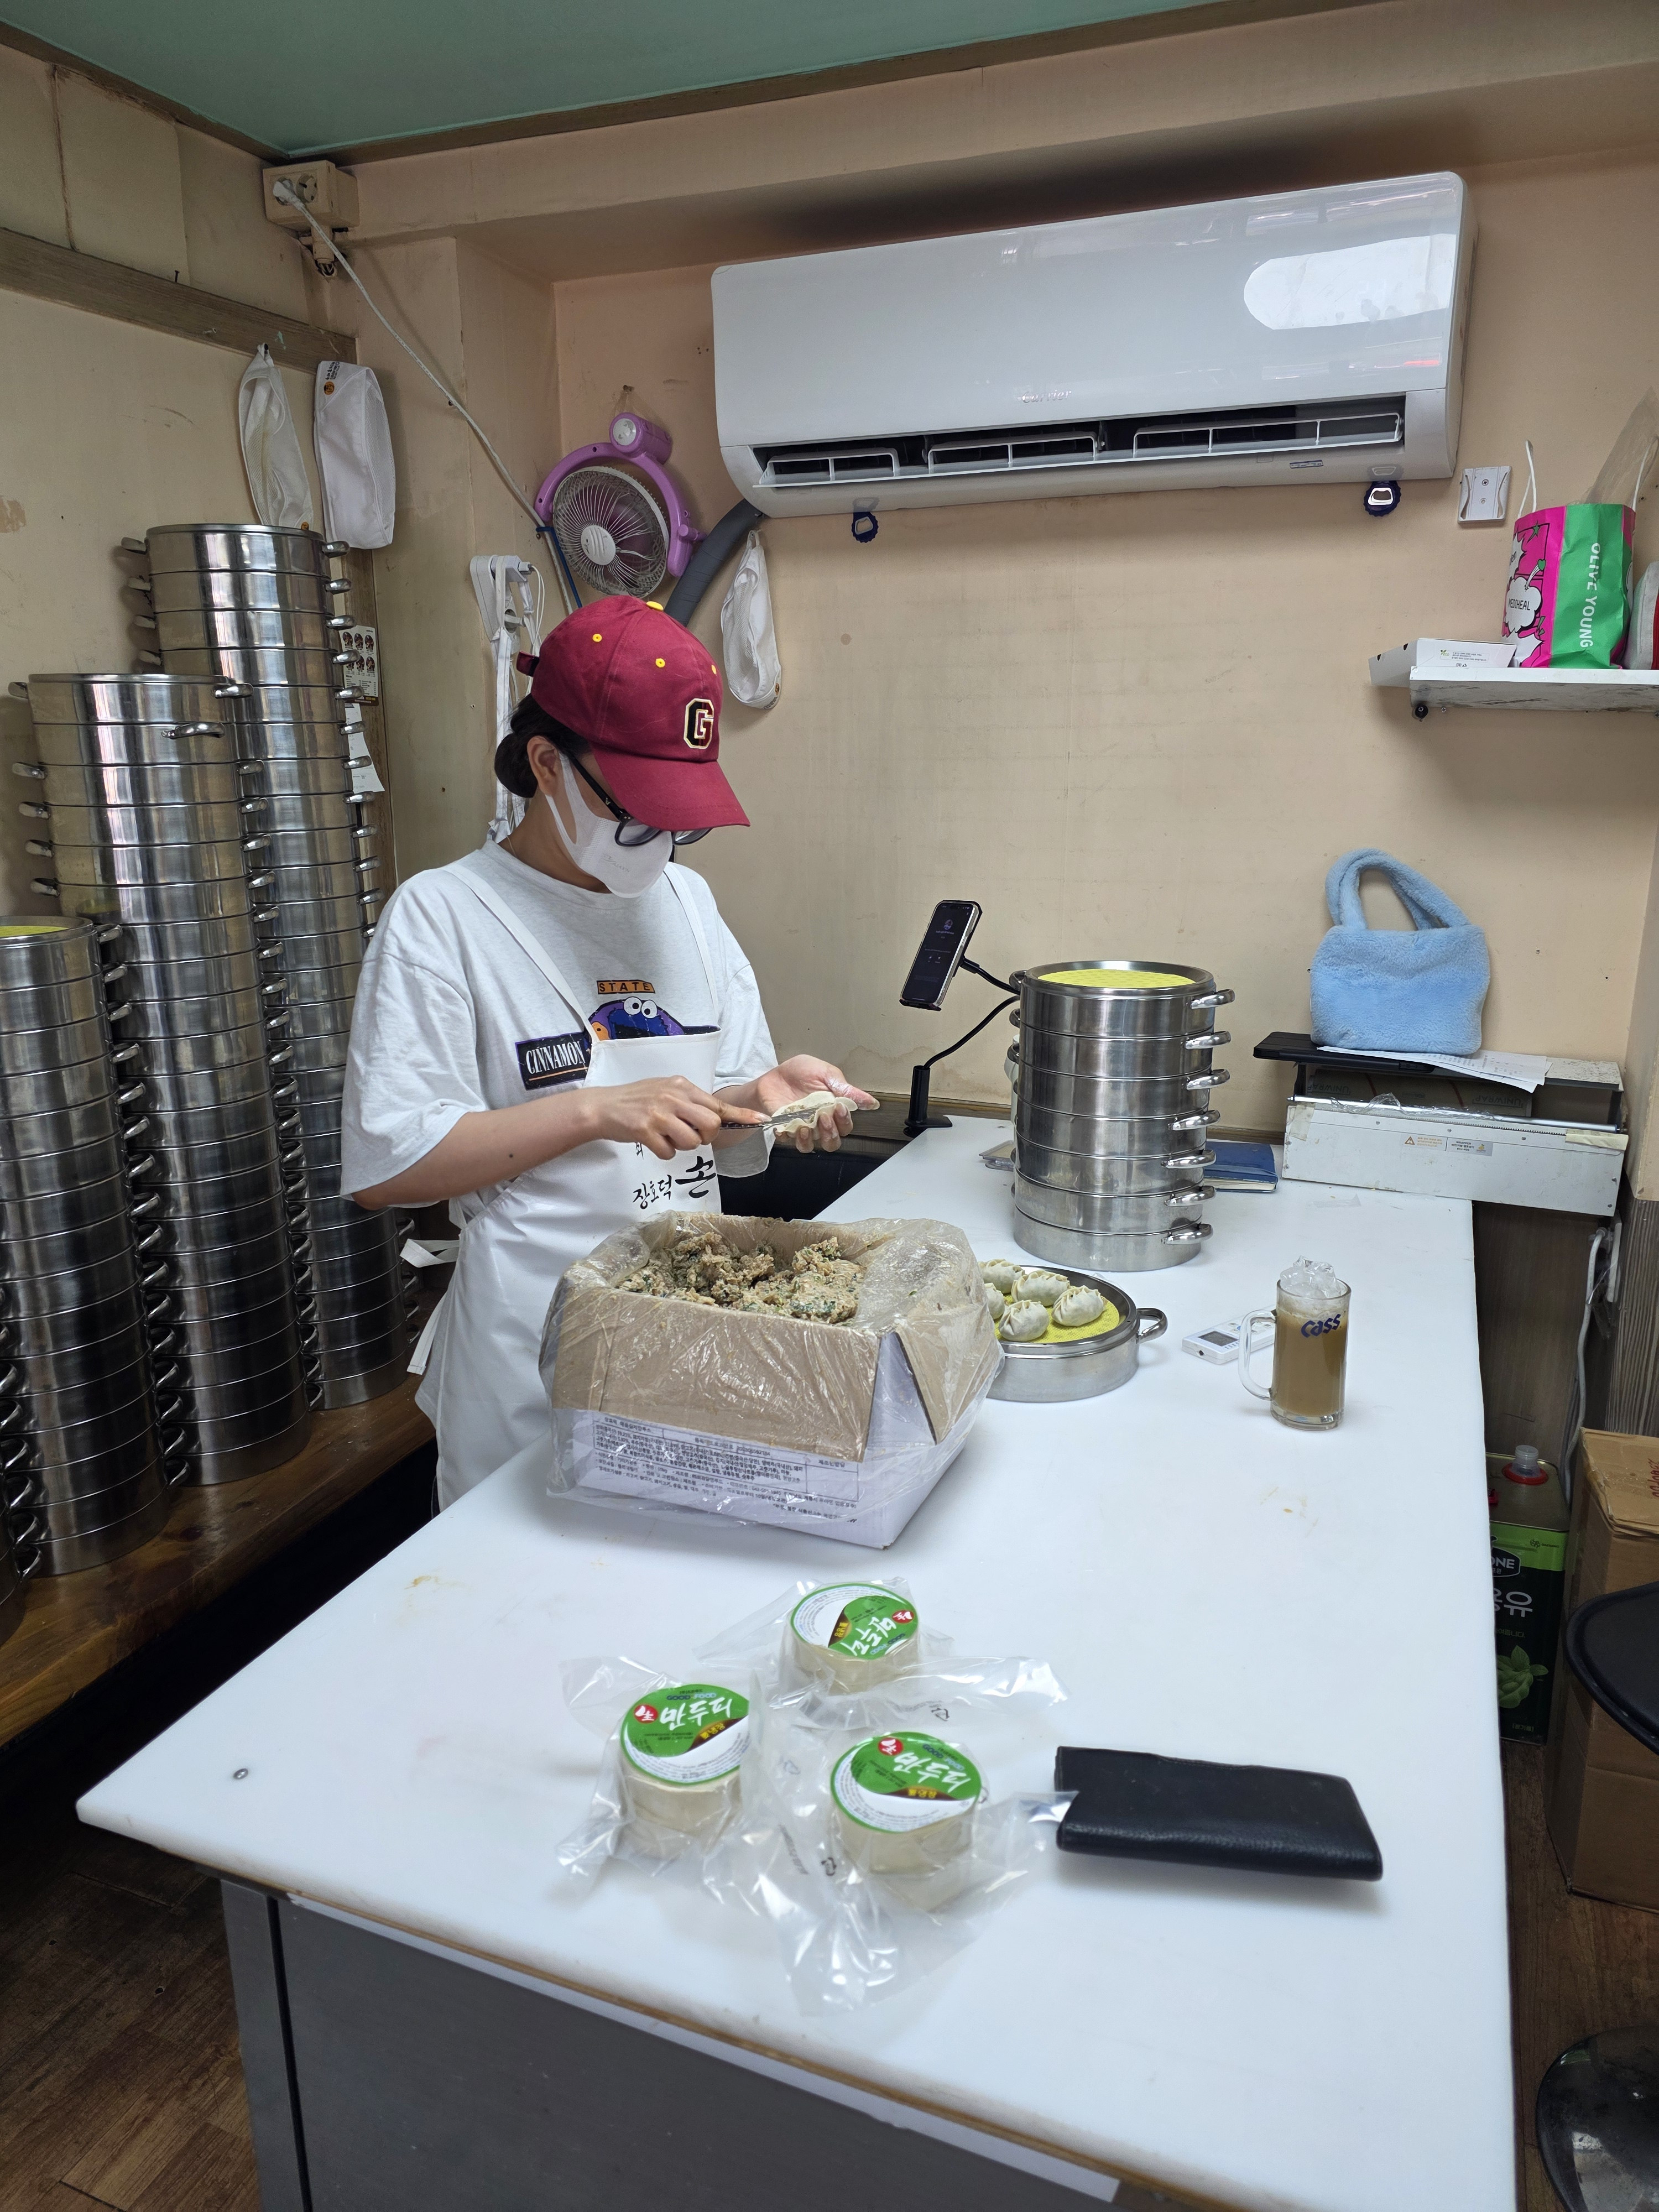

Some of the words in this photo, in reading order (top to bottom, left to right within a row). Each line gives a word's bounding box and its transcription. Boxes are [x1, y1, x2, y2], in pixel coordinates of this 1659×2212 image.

[1021, 389, 1072, 404] Carrier
[1587, 542, 1601, 591] OLIVE
[1508, 598, 1531, 610] MEDIHEAL
[1579, 596, 1598, 648] YOUNG
[684, 698, 714, 749] G
[599, 981, 651, 993] STATE
[525, 1041, 585, 1075] CINNAMON
[1473, 1094, 1522, 1105] UNIWRAP
[633, 1174, 672, 1209] 장호덕
[675, 1156, 716, 1199] 손
[839, 1616, 897, 1656] 만두피
[660, 1697, 733, 1731] 만두피
[893, 1752, 971, 1793] 만두피
